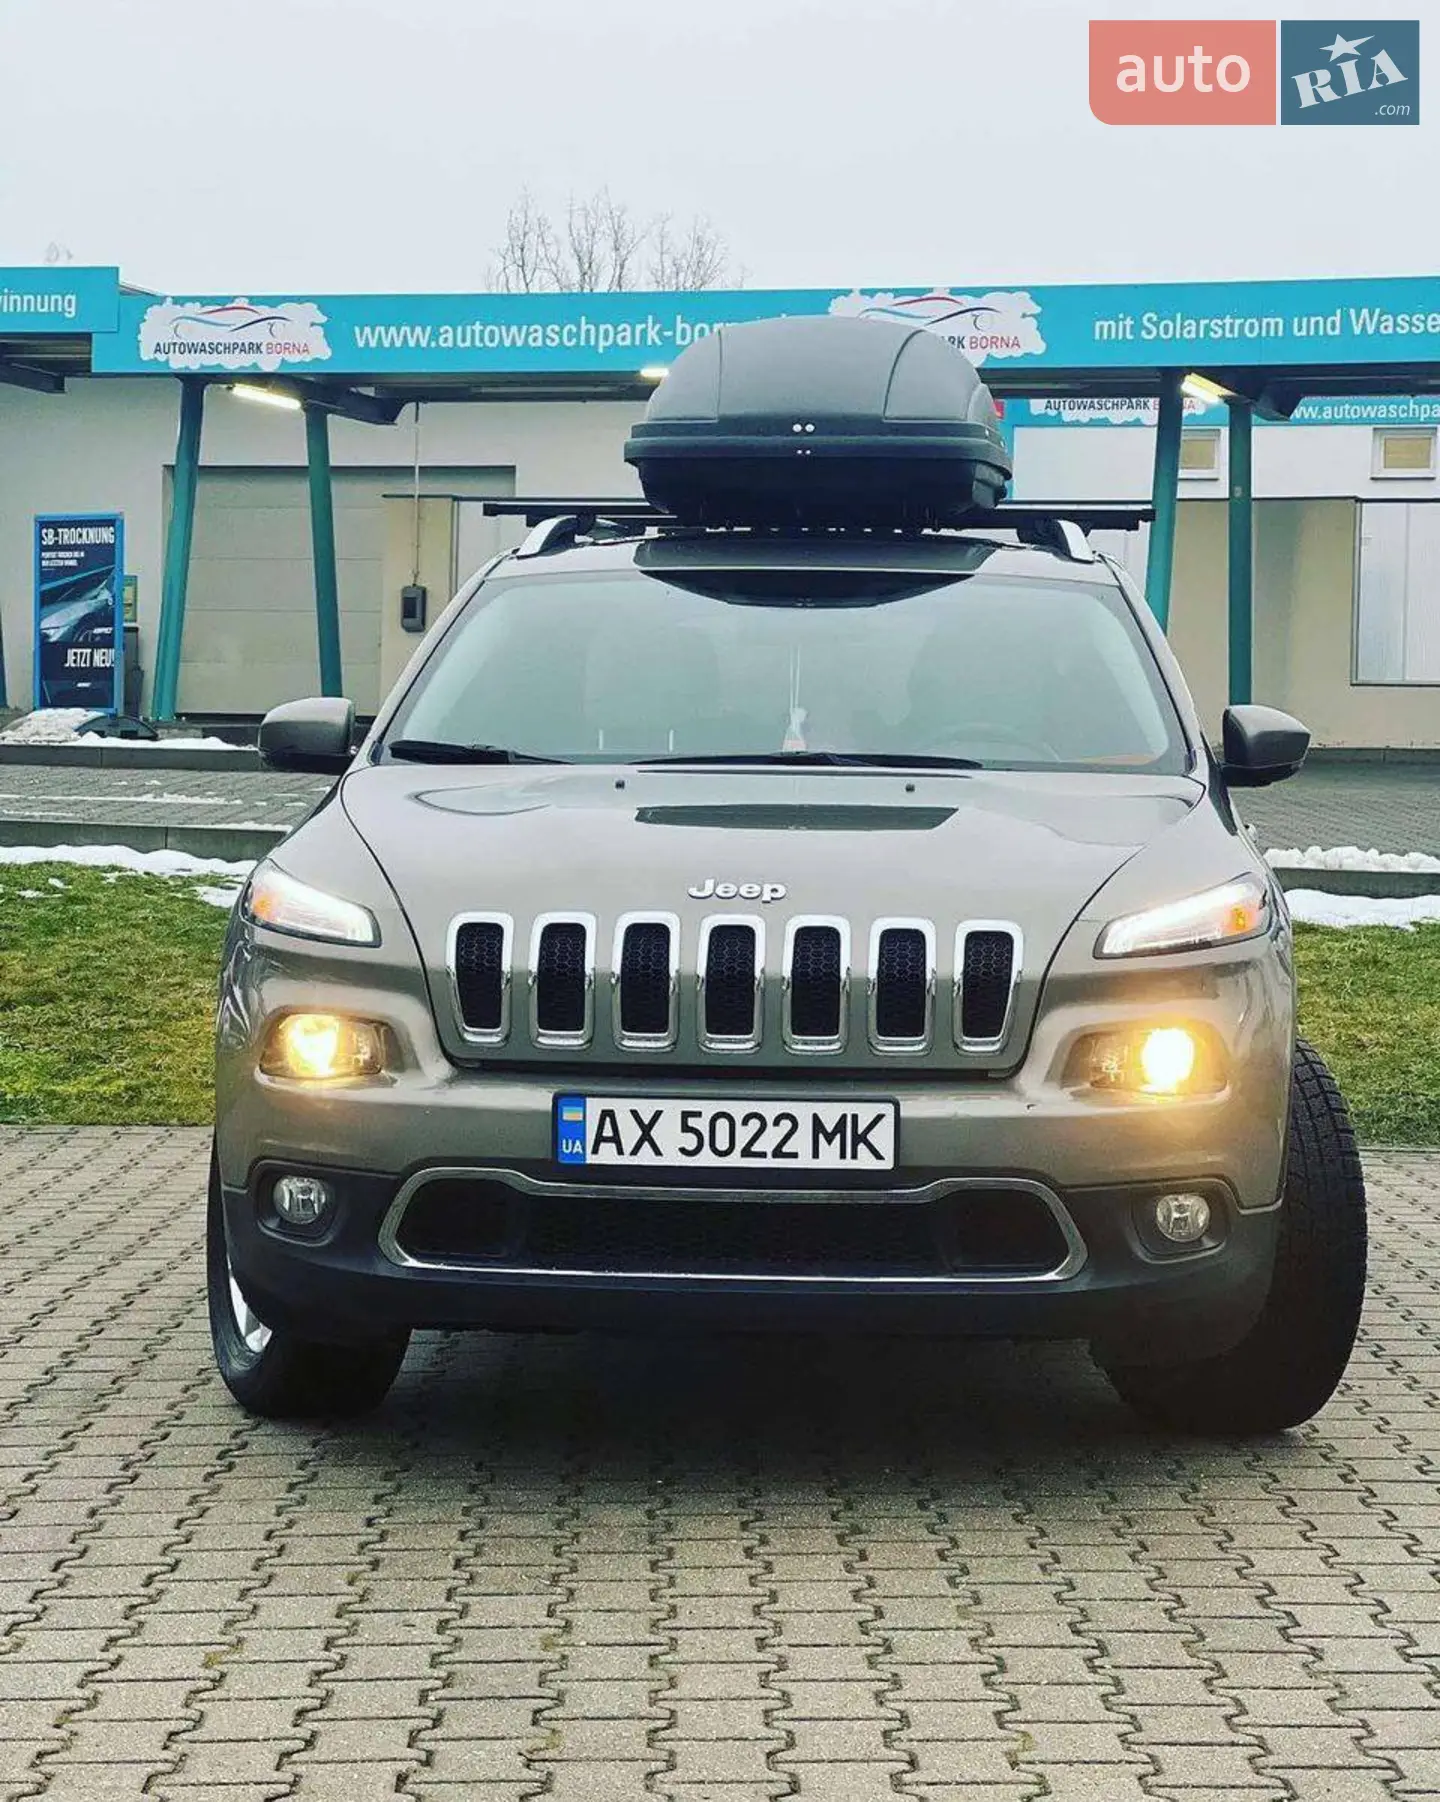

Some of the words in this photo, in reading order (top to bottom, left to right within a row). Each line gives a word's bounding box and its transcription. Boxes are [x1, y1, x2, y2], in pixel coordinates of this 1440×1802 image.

[0, 287, 77, 318] innung
[353, 313, 733, 353] www.autowaschpark-bor
[1094, 313, 1134, 340] mit
[1141, 311, 1284, 340] Solarstrom
[1292, 308, 1342, 336] und
[153, 341, 263, 356] AUTOWASCHPARK
[265, 341, 310, 355] BORNA
[969, 335, 1021, 350] BORNA
[1044, 398, 1150, 411] AUTOWASCHPARK
[41, 526, 115, 545] SB-TROCKNUNG
[64, 648, 92, 668] JETZT
[687, 879, 787, 904] Jeep
[590, 1109, 664, 1156] AX
[677, 1110, 799, 1159] 5022
[811, 1112, 886, 1160] MK
[562, 1139, 583, 1154] UA
